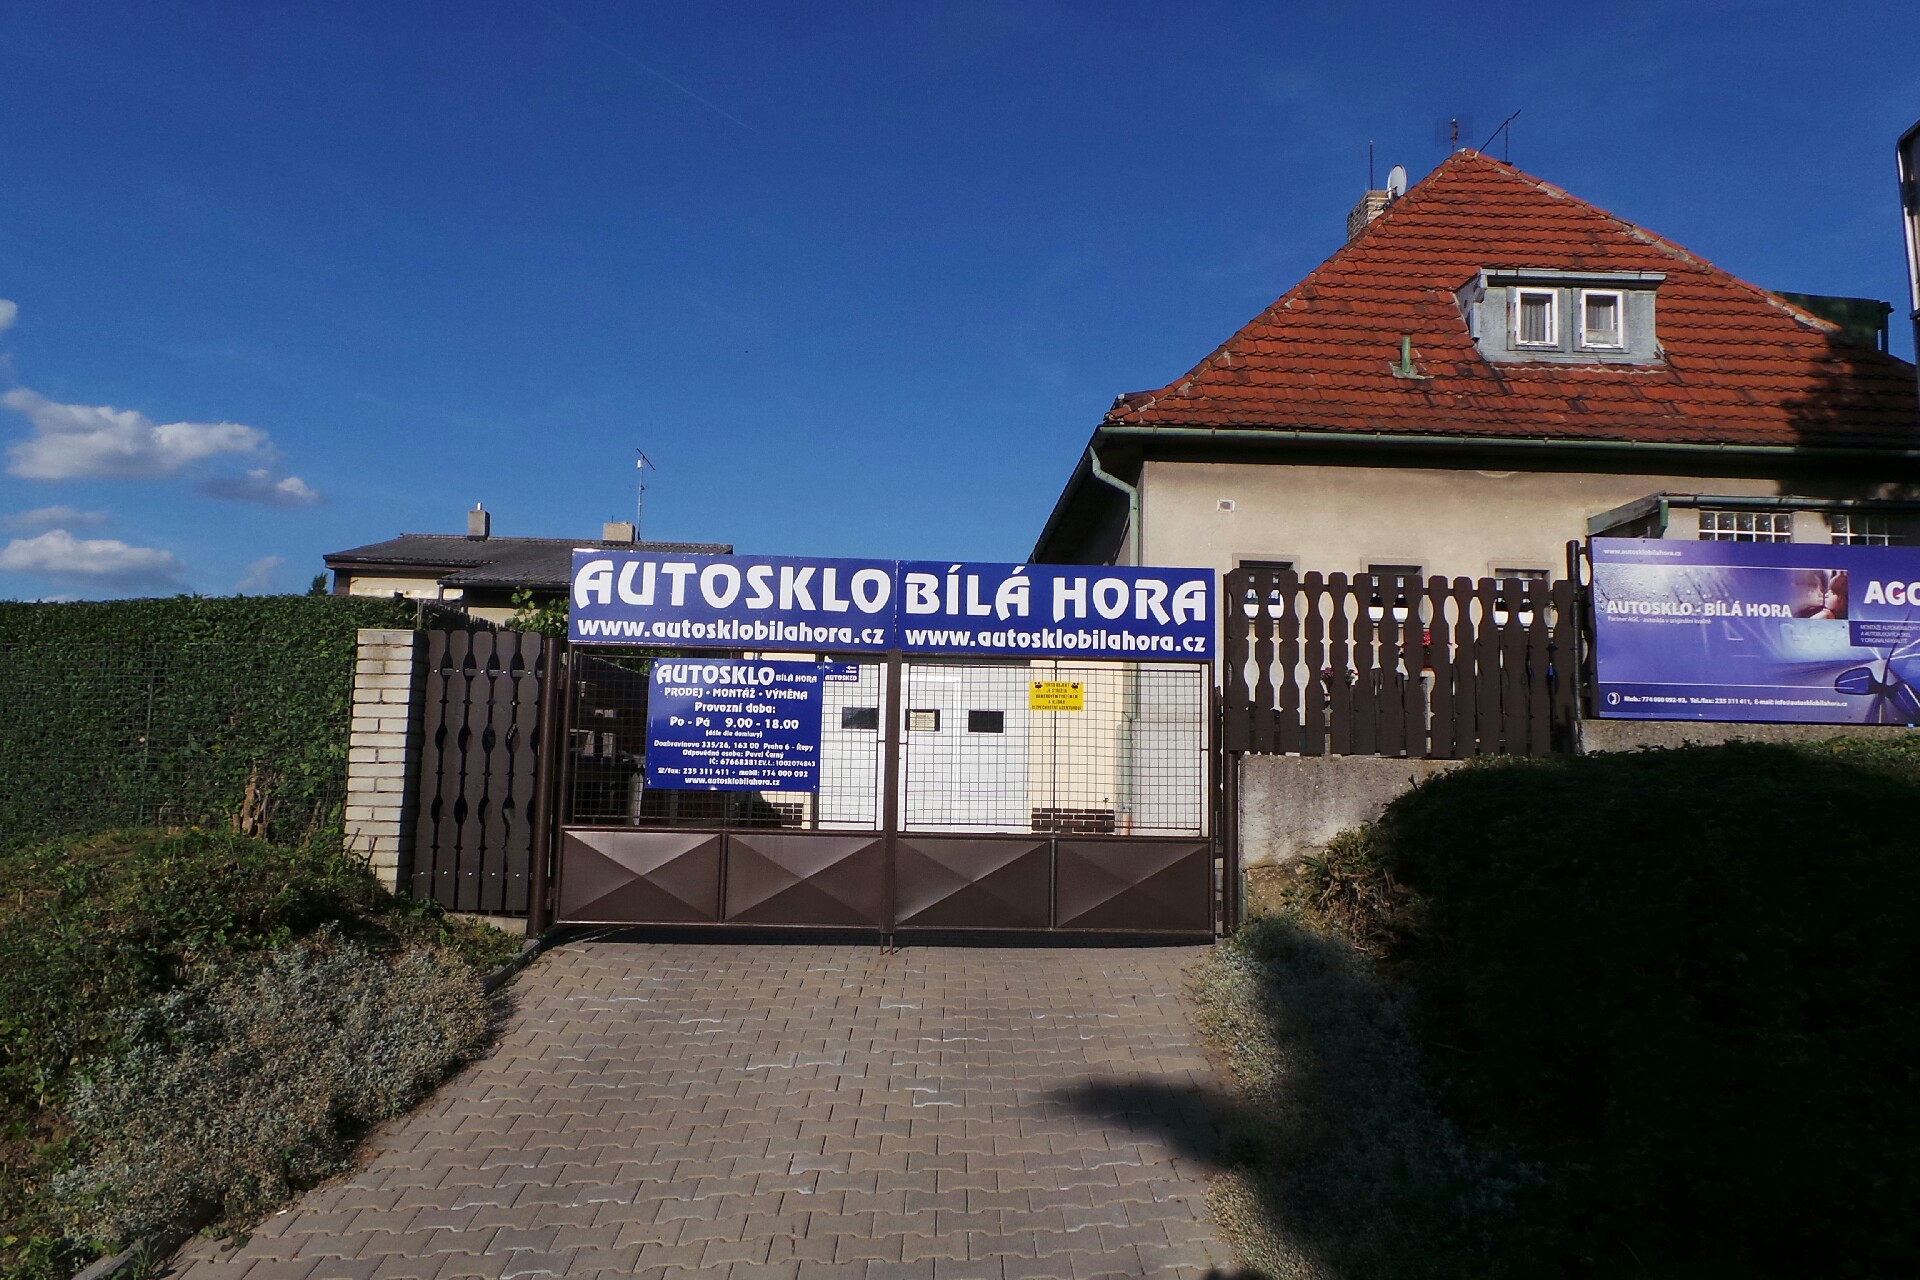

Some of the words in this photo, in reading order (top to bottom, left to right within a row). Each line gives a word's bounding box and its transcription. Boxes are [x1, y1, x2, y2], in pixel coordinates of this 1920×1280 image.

[574, 559, 891, 614] AUTOSKLO
[904, 564, 1031, 621] BÍLÁ
[1052, 577, 1207, 625] HORA
[1607, 600, 1693, 616] AUTOSKLO
[1704, 599, 1742, 617] BÍLÁ
[1746, 603, 1793, 618] HORA
[577, 618, 885, 644] www.autosklobilahora.cz
[905, 628, 1206, 652] www.autosklobilahora.cz
[656, 664, 775, 685] AUTOSKLO
[776, 673, 793, 682] BÍLÁ
[795, 675, 817, 683] HORA
[664, 687, 703, 698] PRODEJ
[712, 688, 756, 698] MONTÁŽ
[765, 688, 808, 700] VÝMĚNA
[694, 701, 742, 713] Provozní
[745, 703, 776, 714] doba:
[670, 716, 685, 726] Po
[695, 716, 710, 727] Pá
[725, 717, 753, 729] 9.00
[765, 718, 799, 730] 18.00
[701, 741, 731, 749] 335/26,
[796, 742, 814, 752] Řepy
[682, 749, 720, 757] Odpovědná
[745, 750, 764, 758] Pavel
[765, 750, 784, 759] Černý
[709, 757, 719, 765] IČ:
[682, 767, 697, 775] 235
[762, 769, 776, 777] 774
[684, 777, 780, 786] www.autosklobilahora.cz
